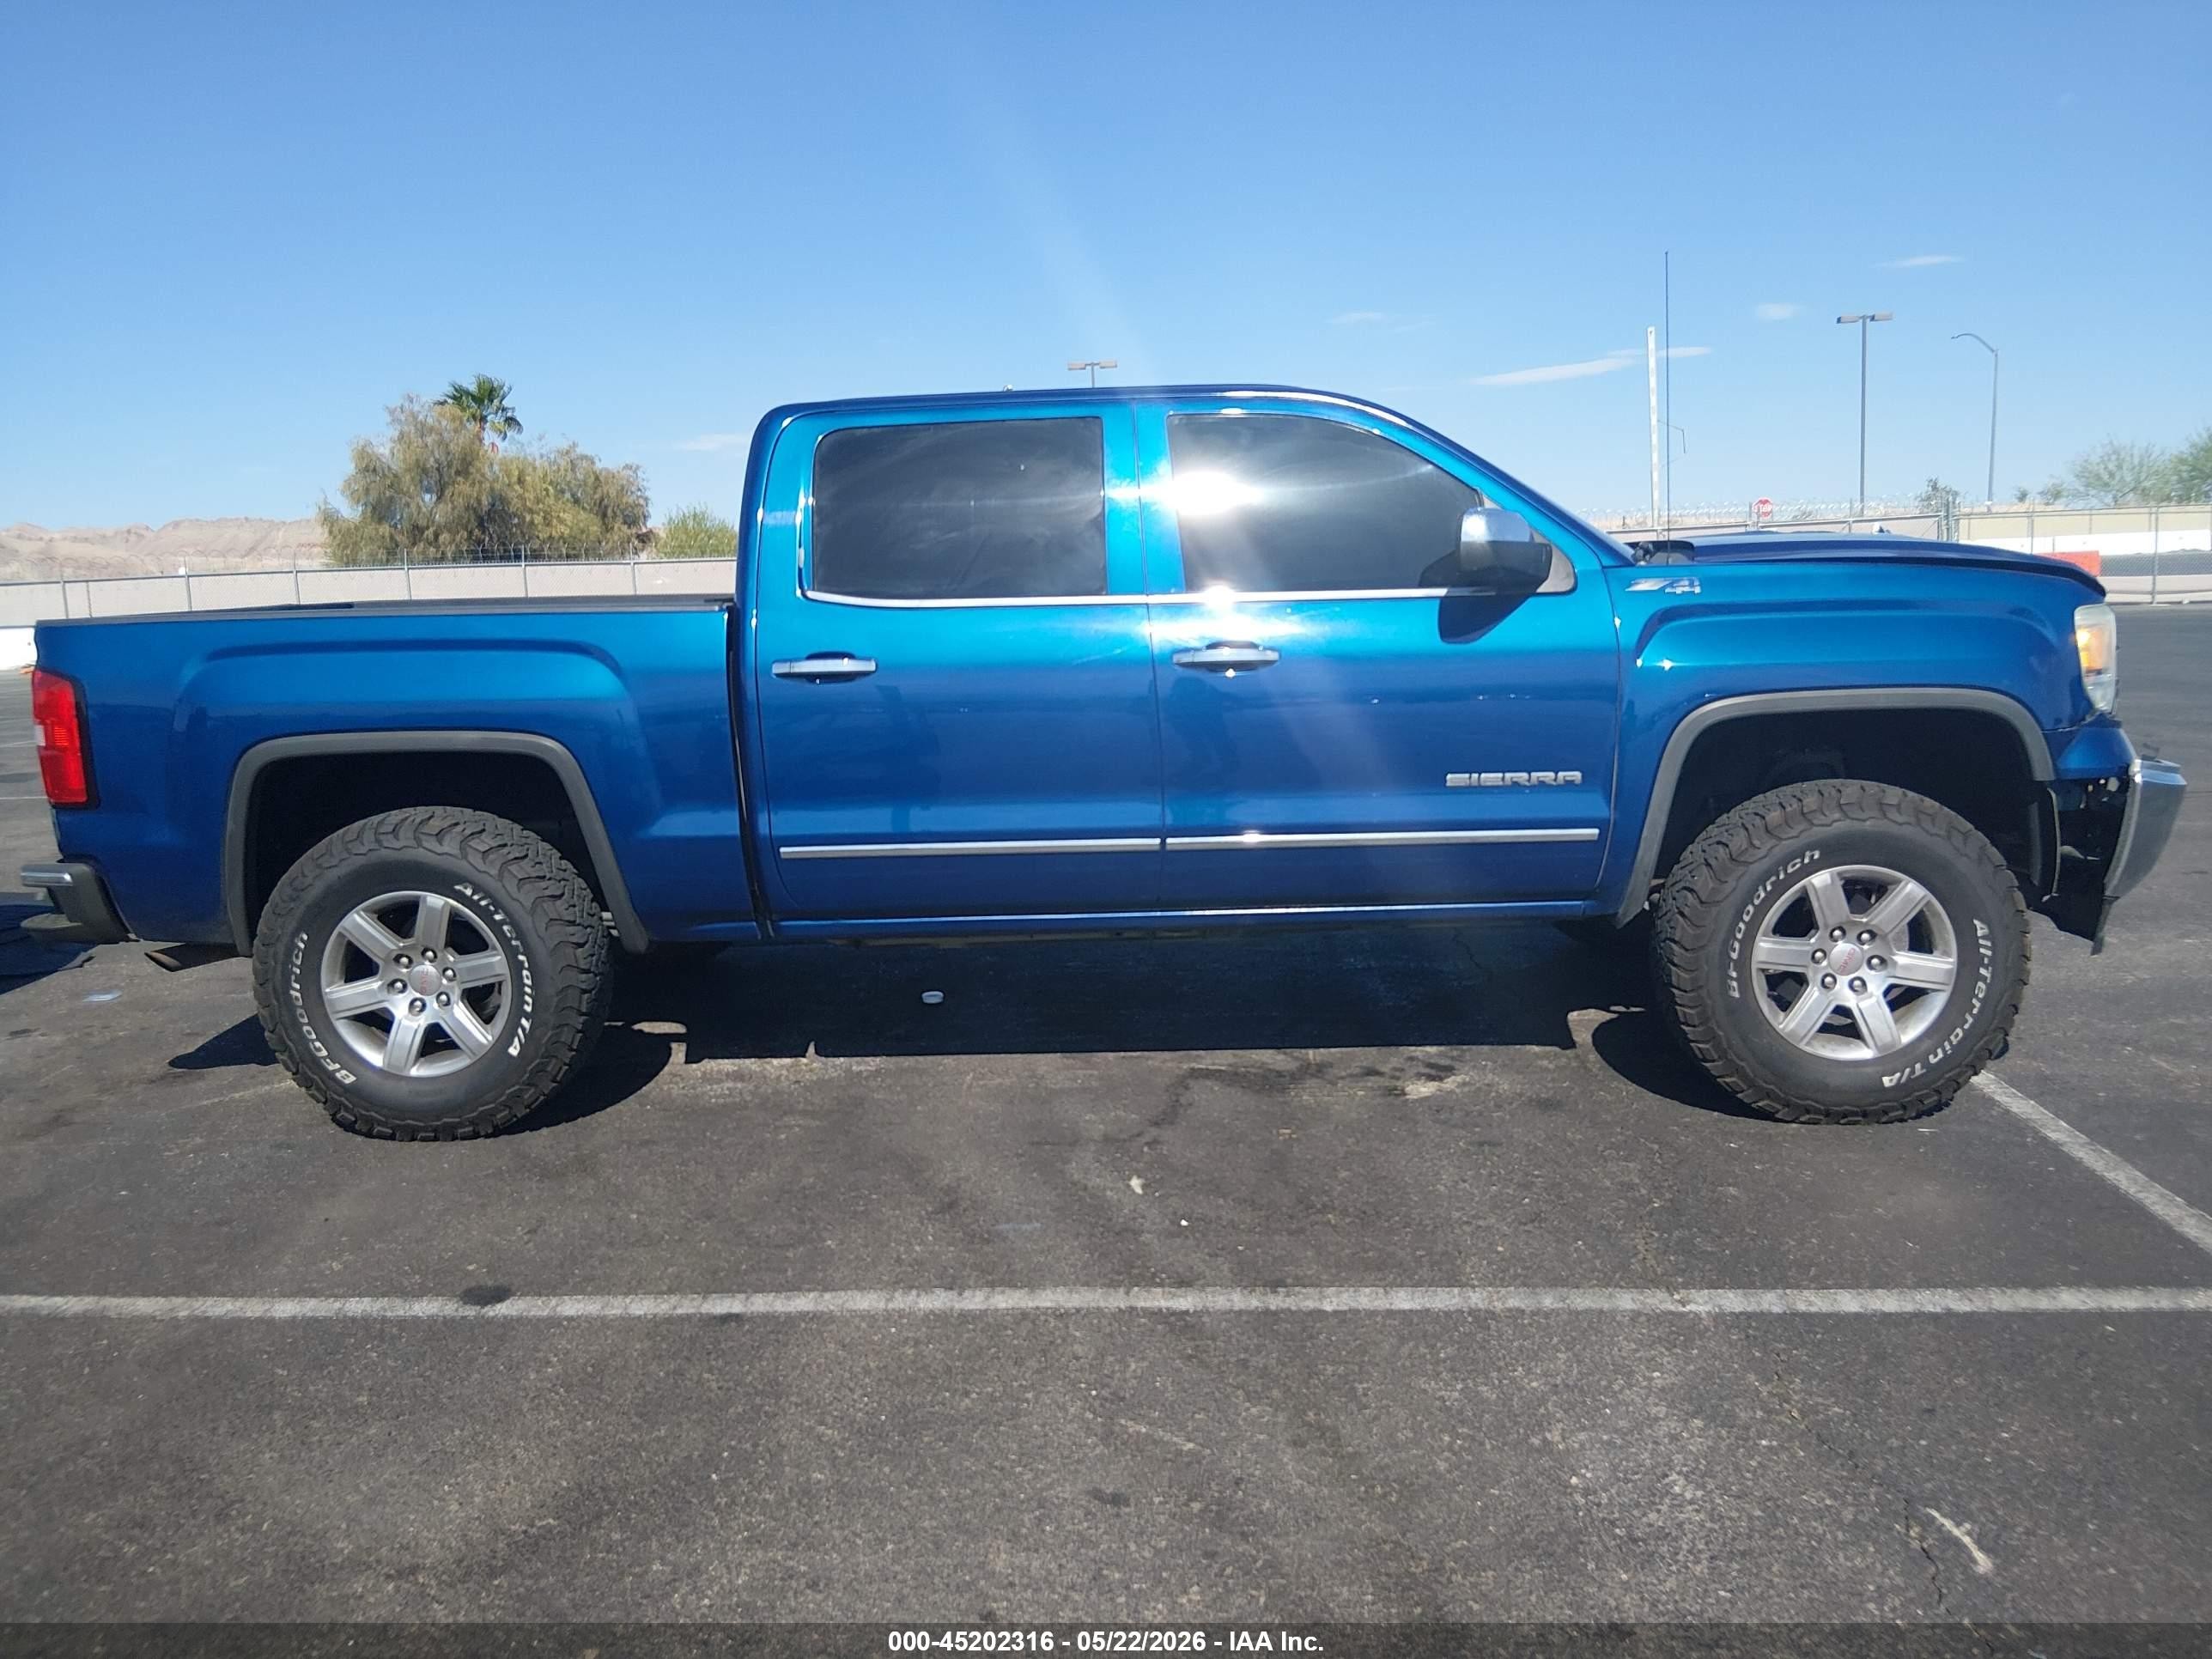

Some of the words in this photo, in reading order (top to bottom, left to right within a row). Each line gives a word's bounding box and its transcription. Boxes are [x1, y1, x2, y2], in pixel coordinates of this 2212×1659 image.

[1445, 770, 1583, 787] SIERRA
[287, 930, 357, 1085] BFGoodrich
[454, 881, 537, 1014] All-Terrain
[507, 1017, 534, 1059] T/A
[1929, 918, 1994, 1065] All-Terrain
[1881, 1063, 1929, 1089] T/A
